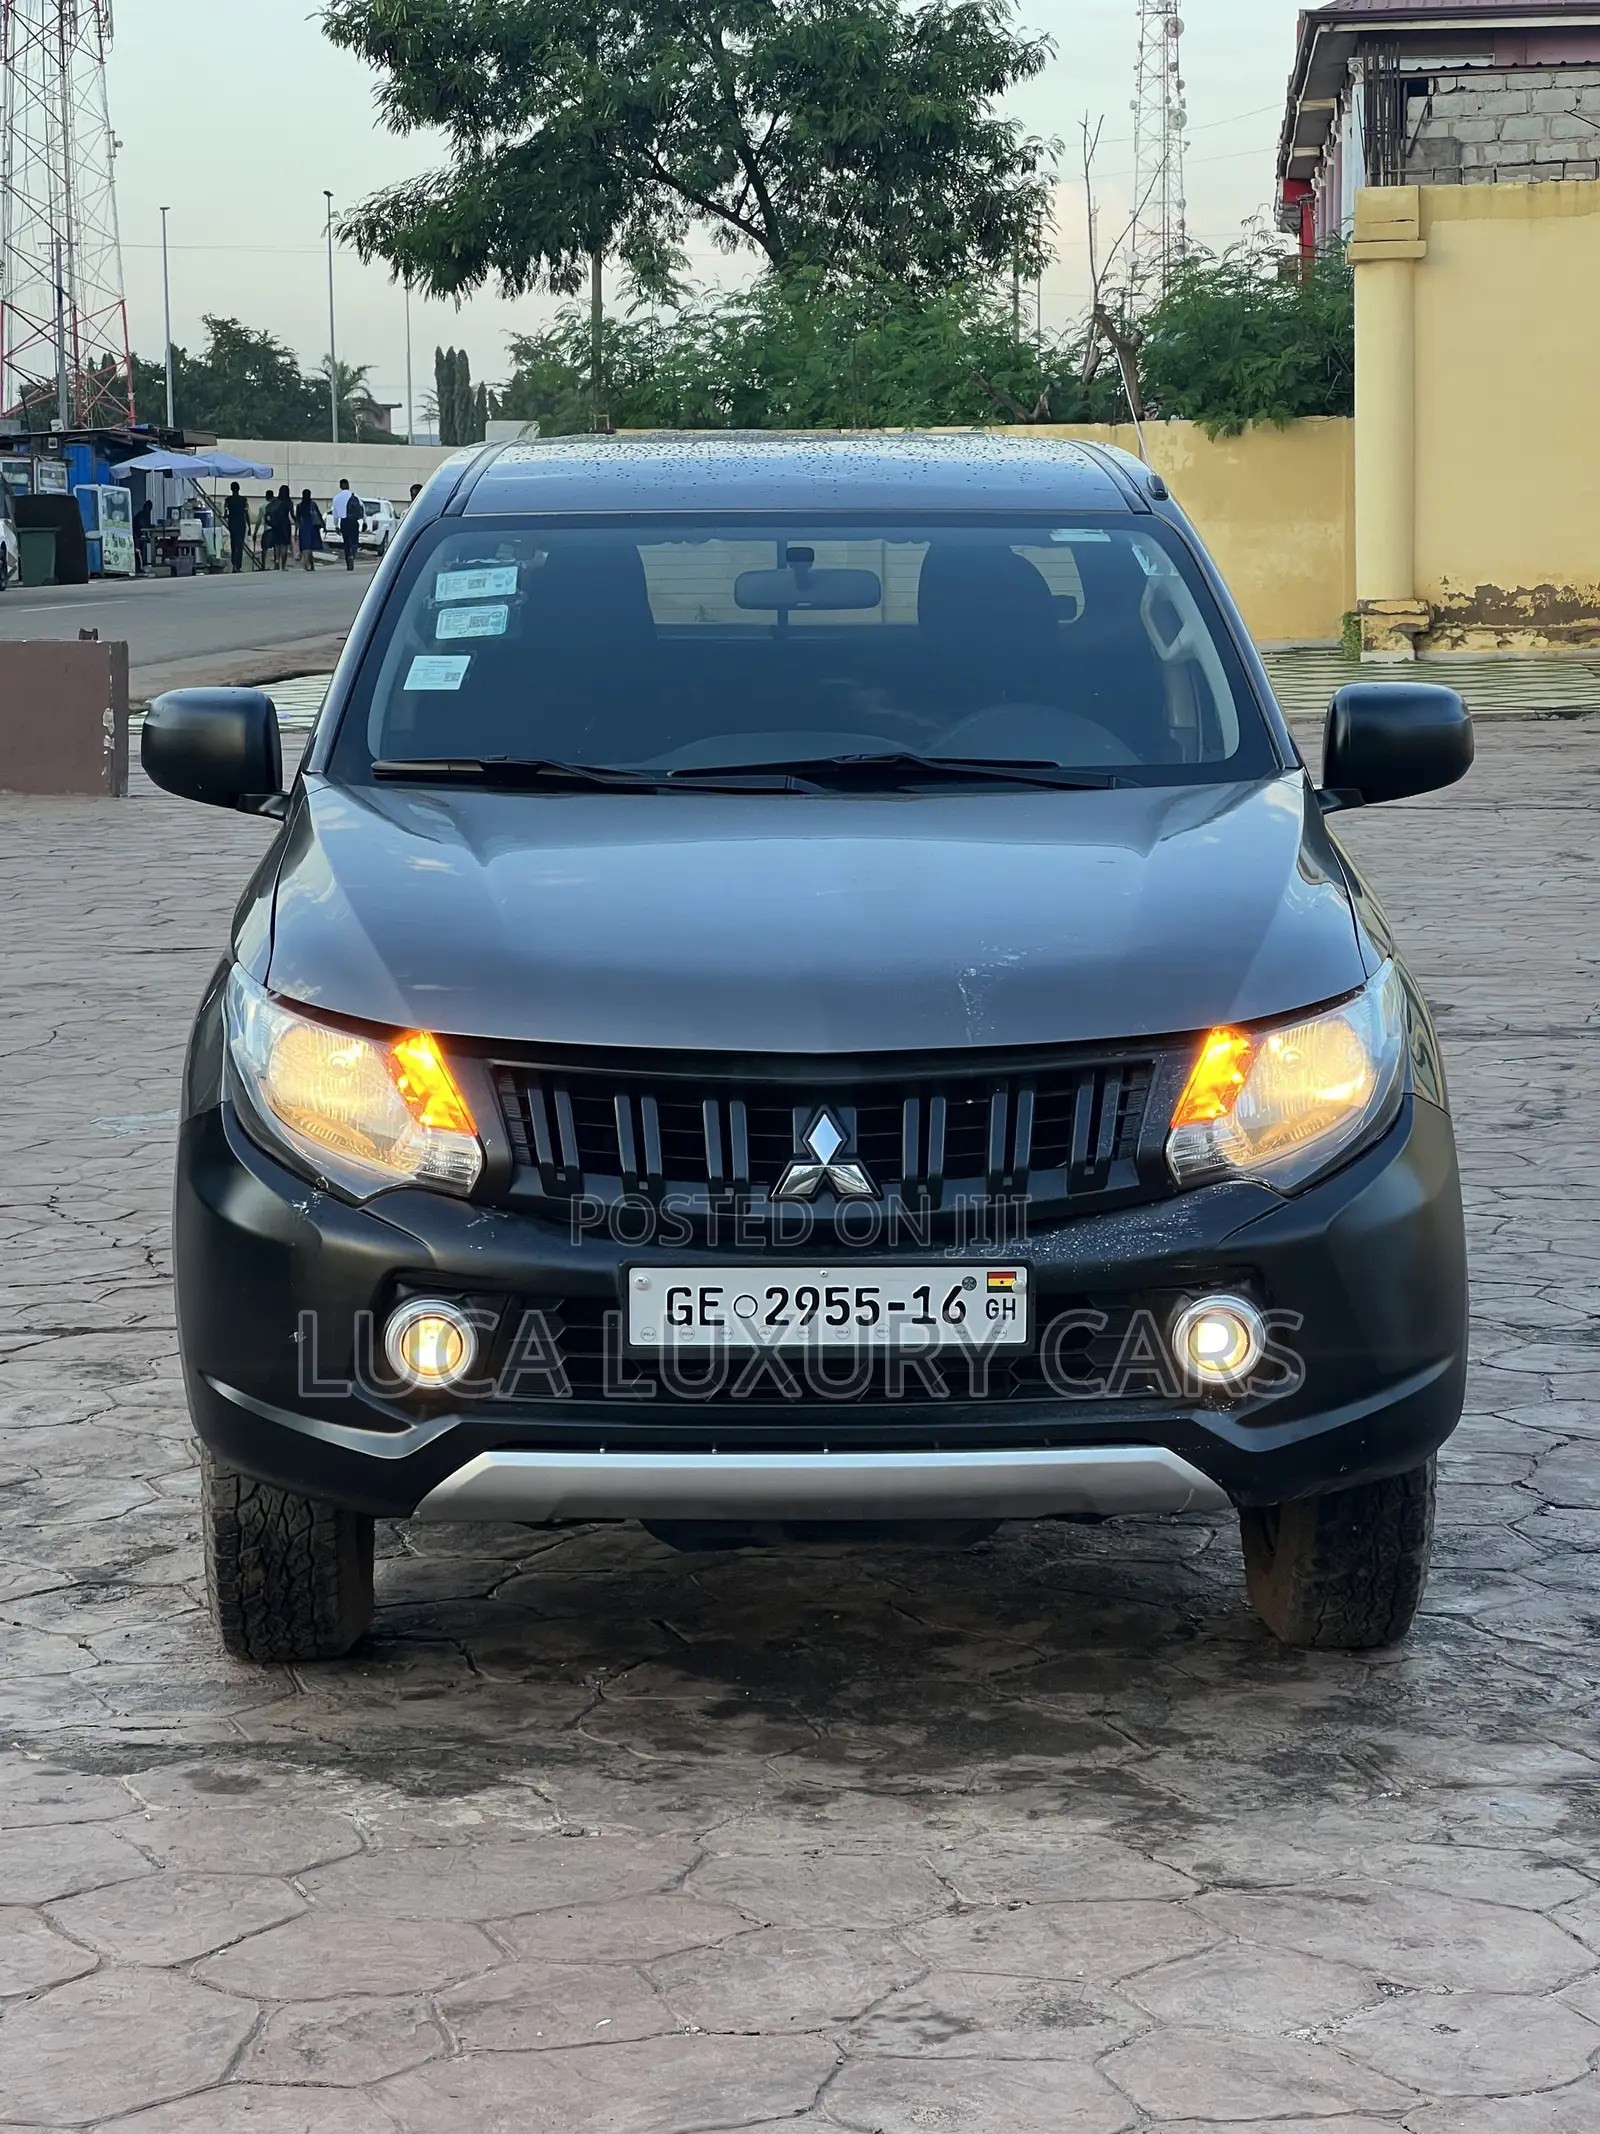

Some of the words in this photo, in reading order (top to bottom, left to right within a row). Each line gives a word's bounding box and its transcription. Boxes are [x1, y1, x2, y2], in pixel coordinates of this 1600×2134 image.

[666, 1286, 726, 1326] GE
[764, 1285, 967, 1327] 2955-16
[985, 1298, 1017, 1320] GH
